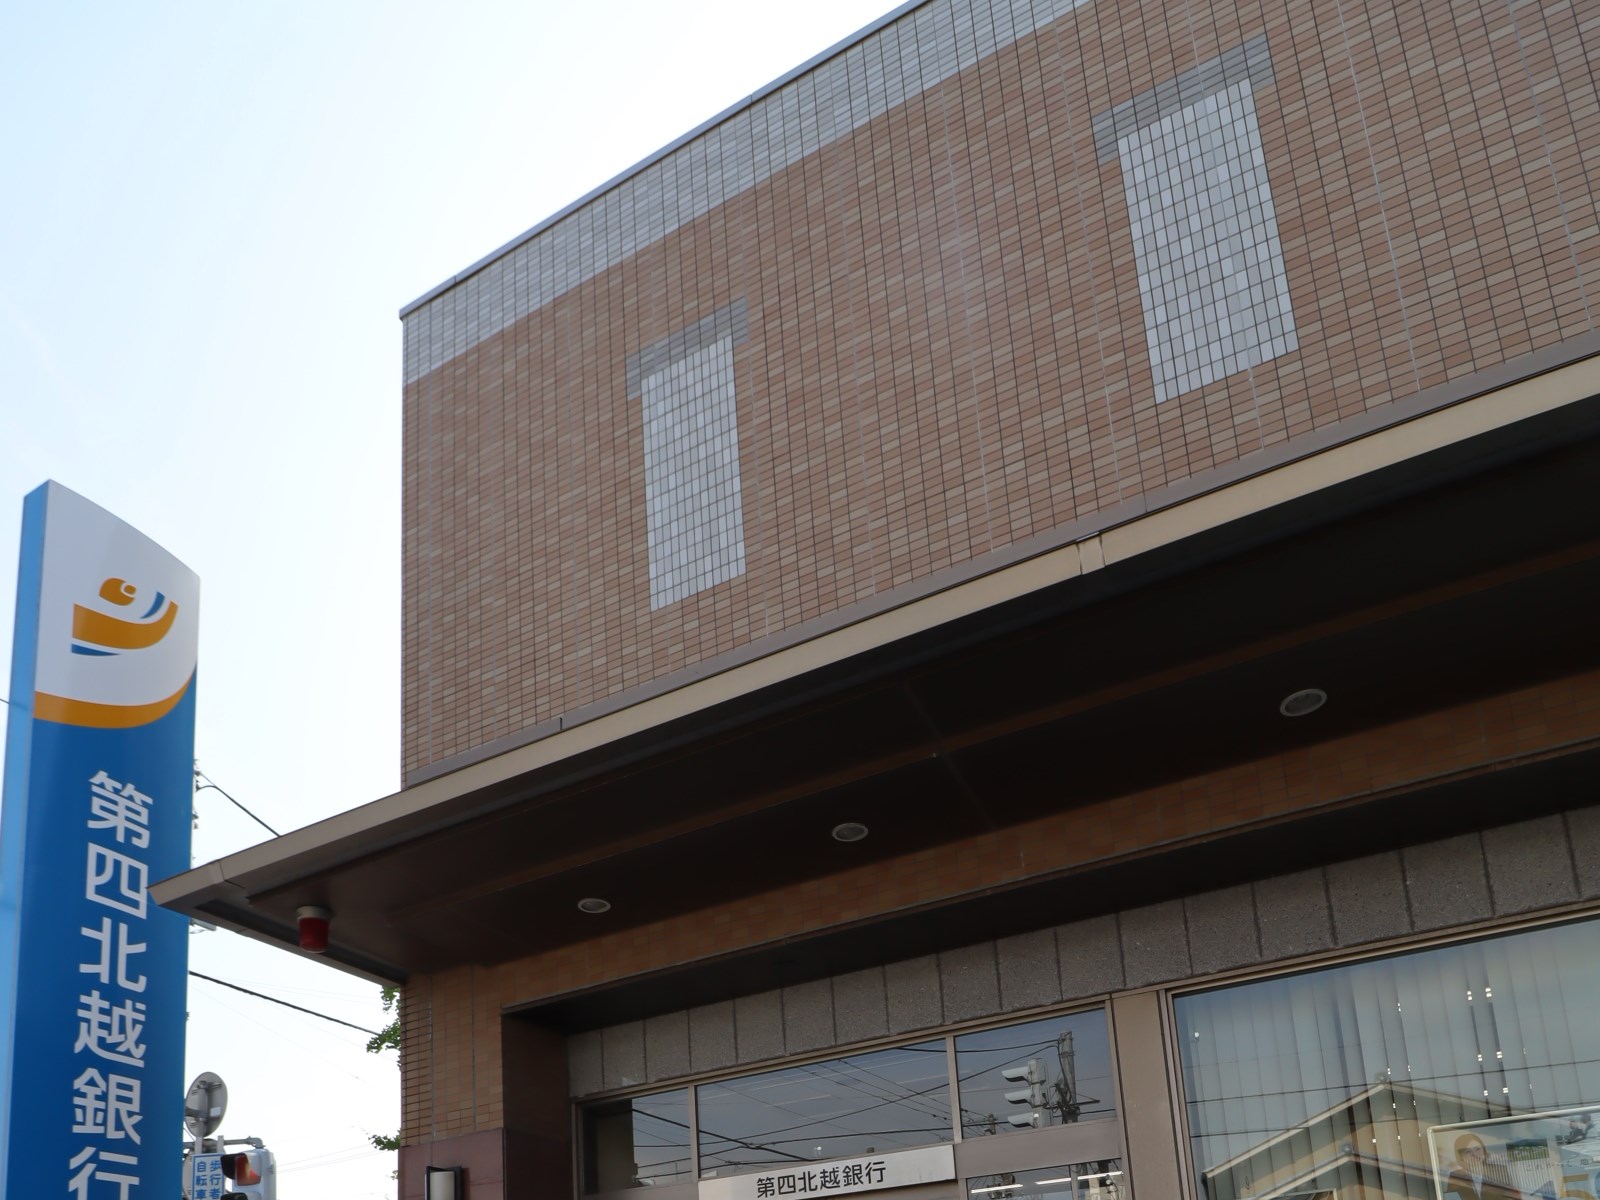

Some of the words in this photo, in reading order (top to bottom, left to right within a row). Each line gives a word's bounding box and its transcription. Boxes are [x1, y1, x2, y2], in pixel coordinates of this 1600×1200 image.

[195, 1160, 207, 1200] 自転車
[209, 1160, 221, 1200] 歩行者
[756, 1161, 886, 1199] 第四北越銀行
